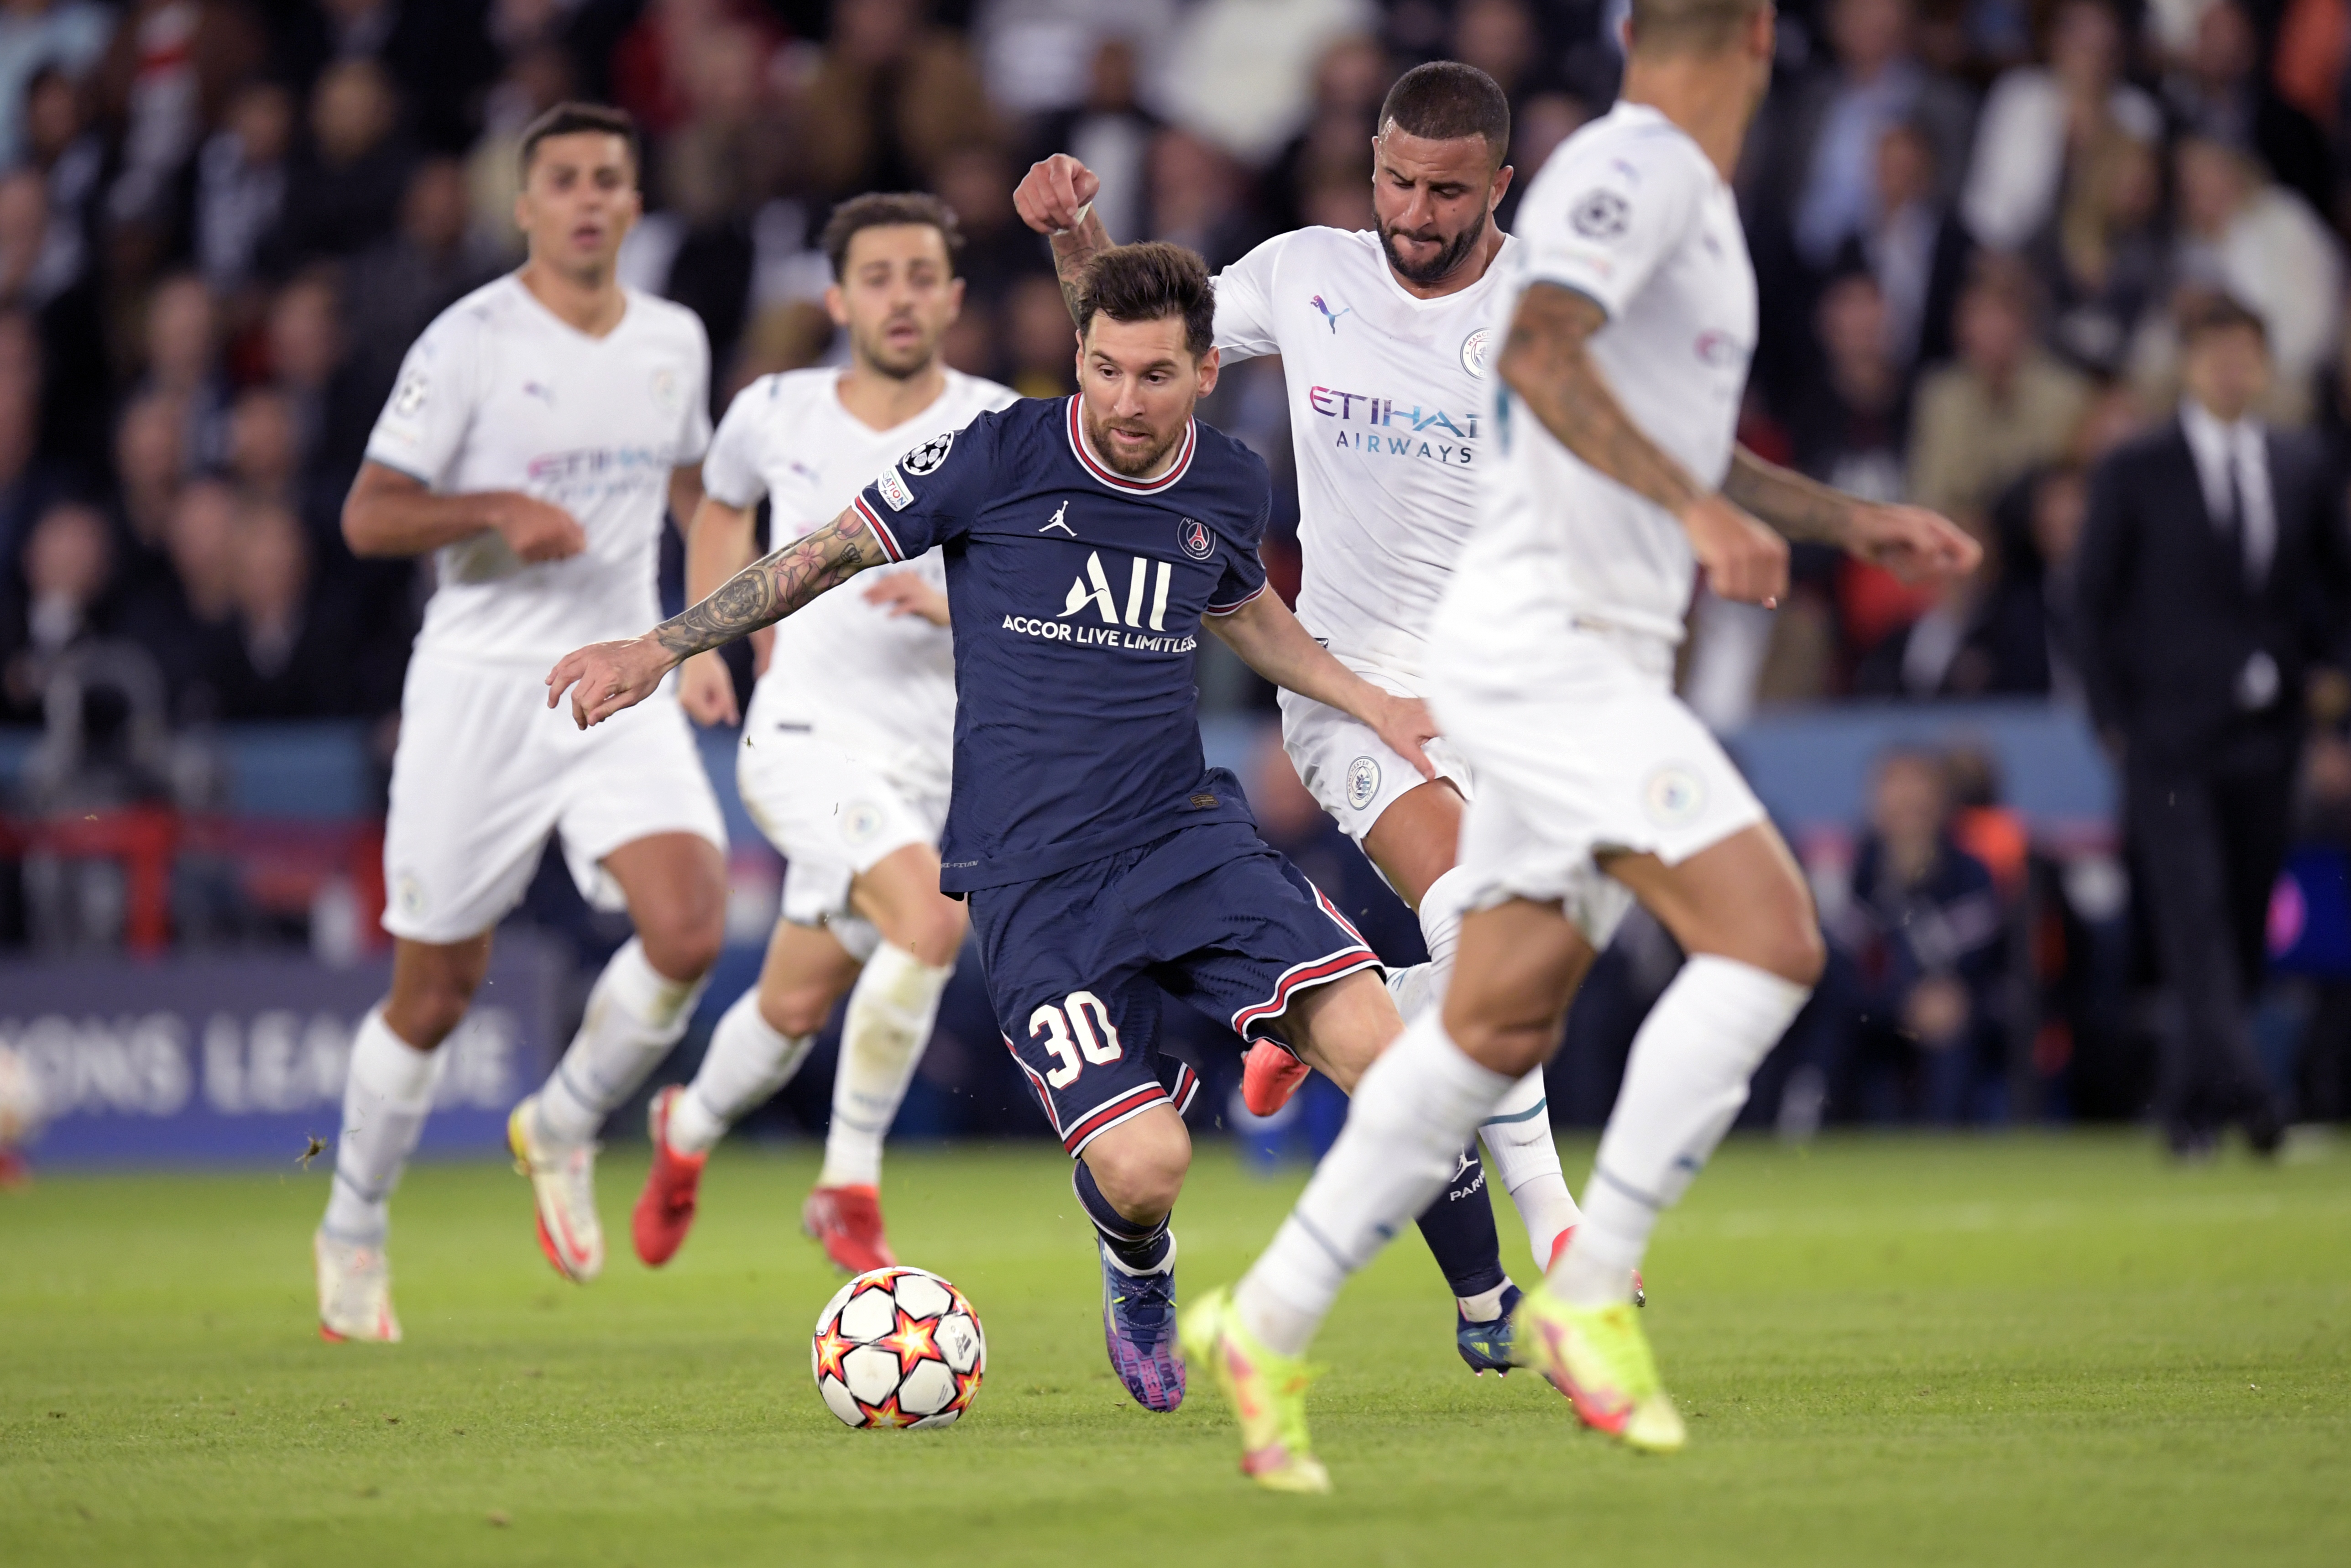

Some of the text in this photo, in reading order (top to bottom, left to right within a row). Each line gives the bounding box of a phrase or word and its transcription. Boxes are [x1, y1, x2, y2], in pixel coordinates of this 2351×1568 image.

[1337, 431, 1472, 464] AIRWAYS
[1002, 614, 1071, 641] ACCOR
[1076, 626, 1121, 647] LIVE
[1029, 991, 1124, 1089] 30
